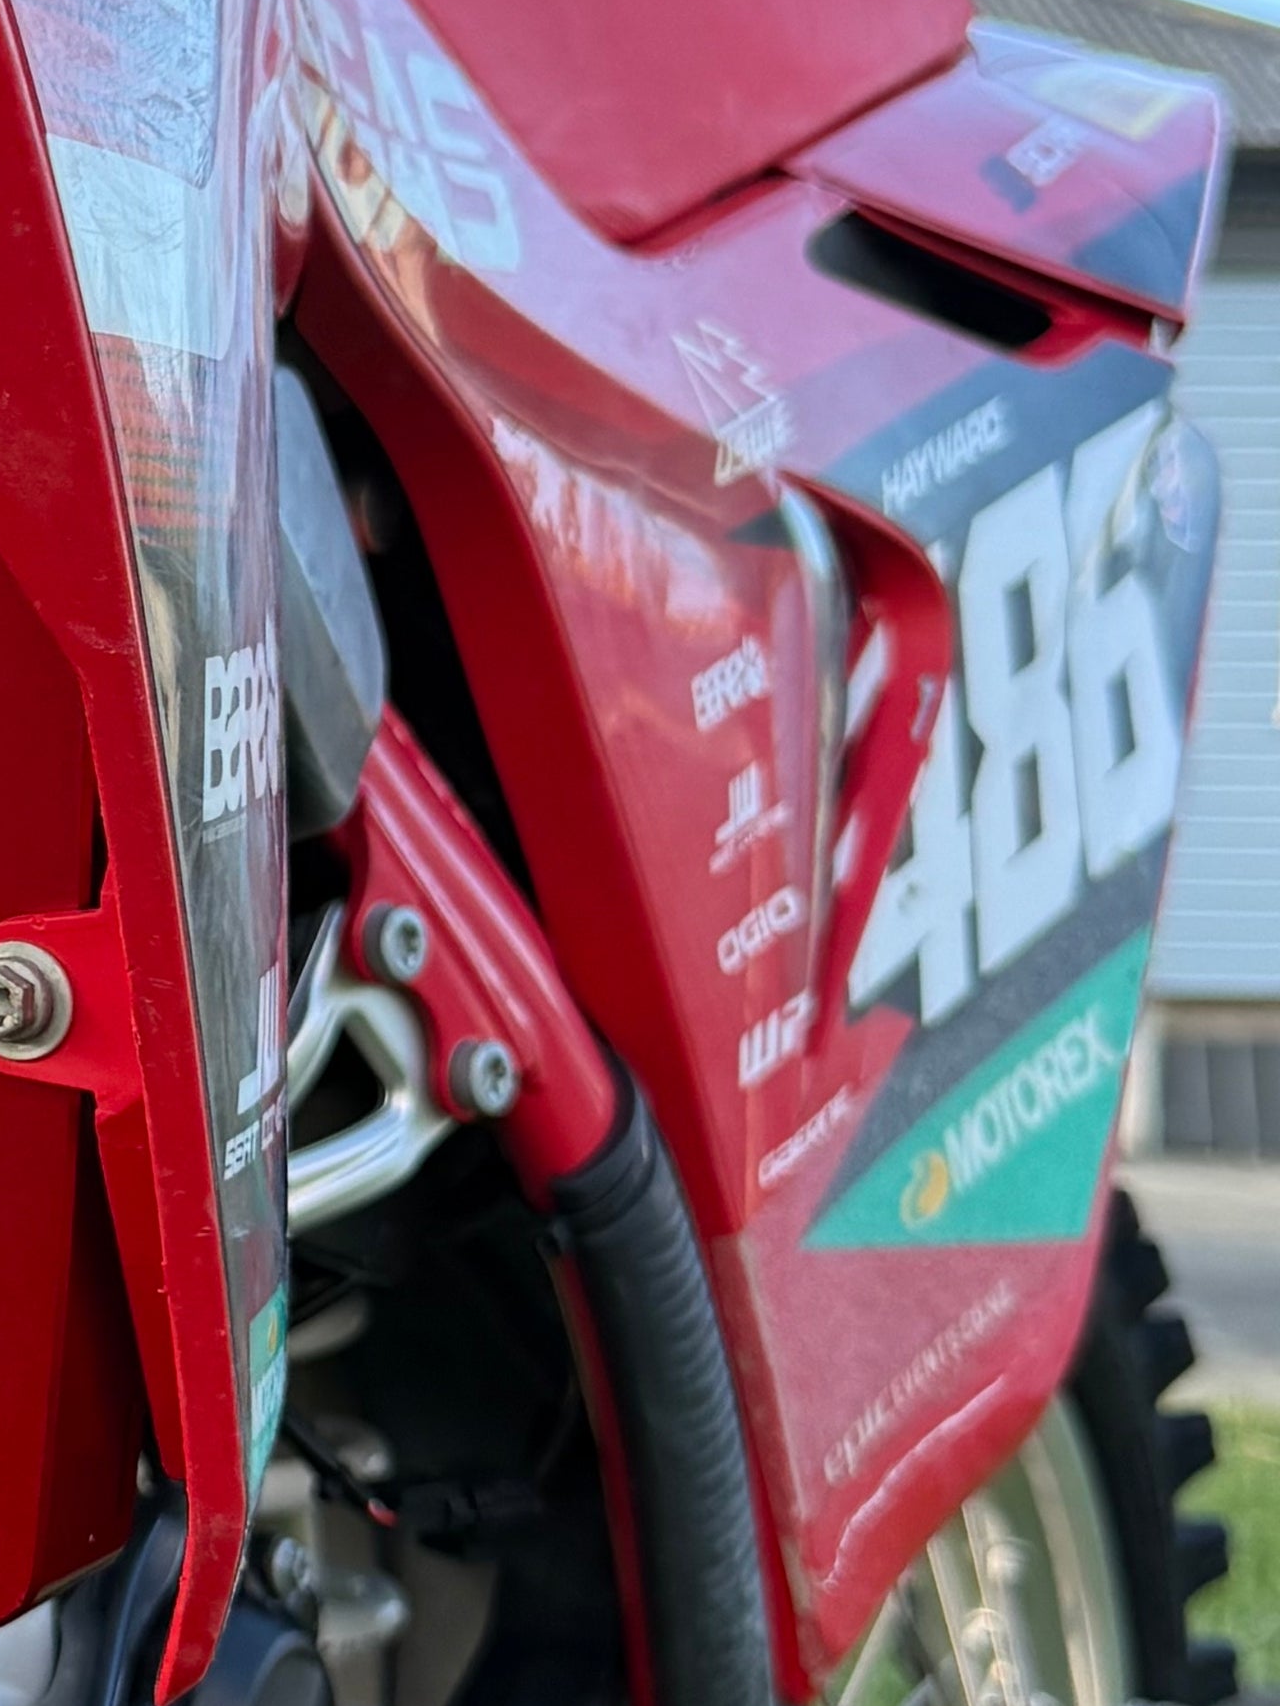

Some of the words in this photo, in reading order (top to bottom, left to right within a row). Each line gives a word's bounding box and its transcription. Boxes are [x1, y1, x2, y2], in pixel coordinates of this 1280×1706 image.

[881, 397, 1007, 514] HAYWARD
[848, 396, 1182, 1030] 486
[717, 886, 801, 976] OGIO
[739, 989, 814, 1090] WP
[943, 1002, 1117, 1195] MOTOREX
